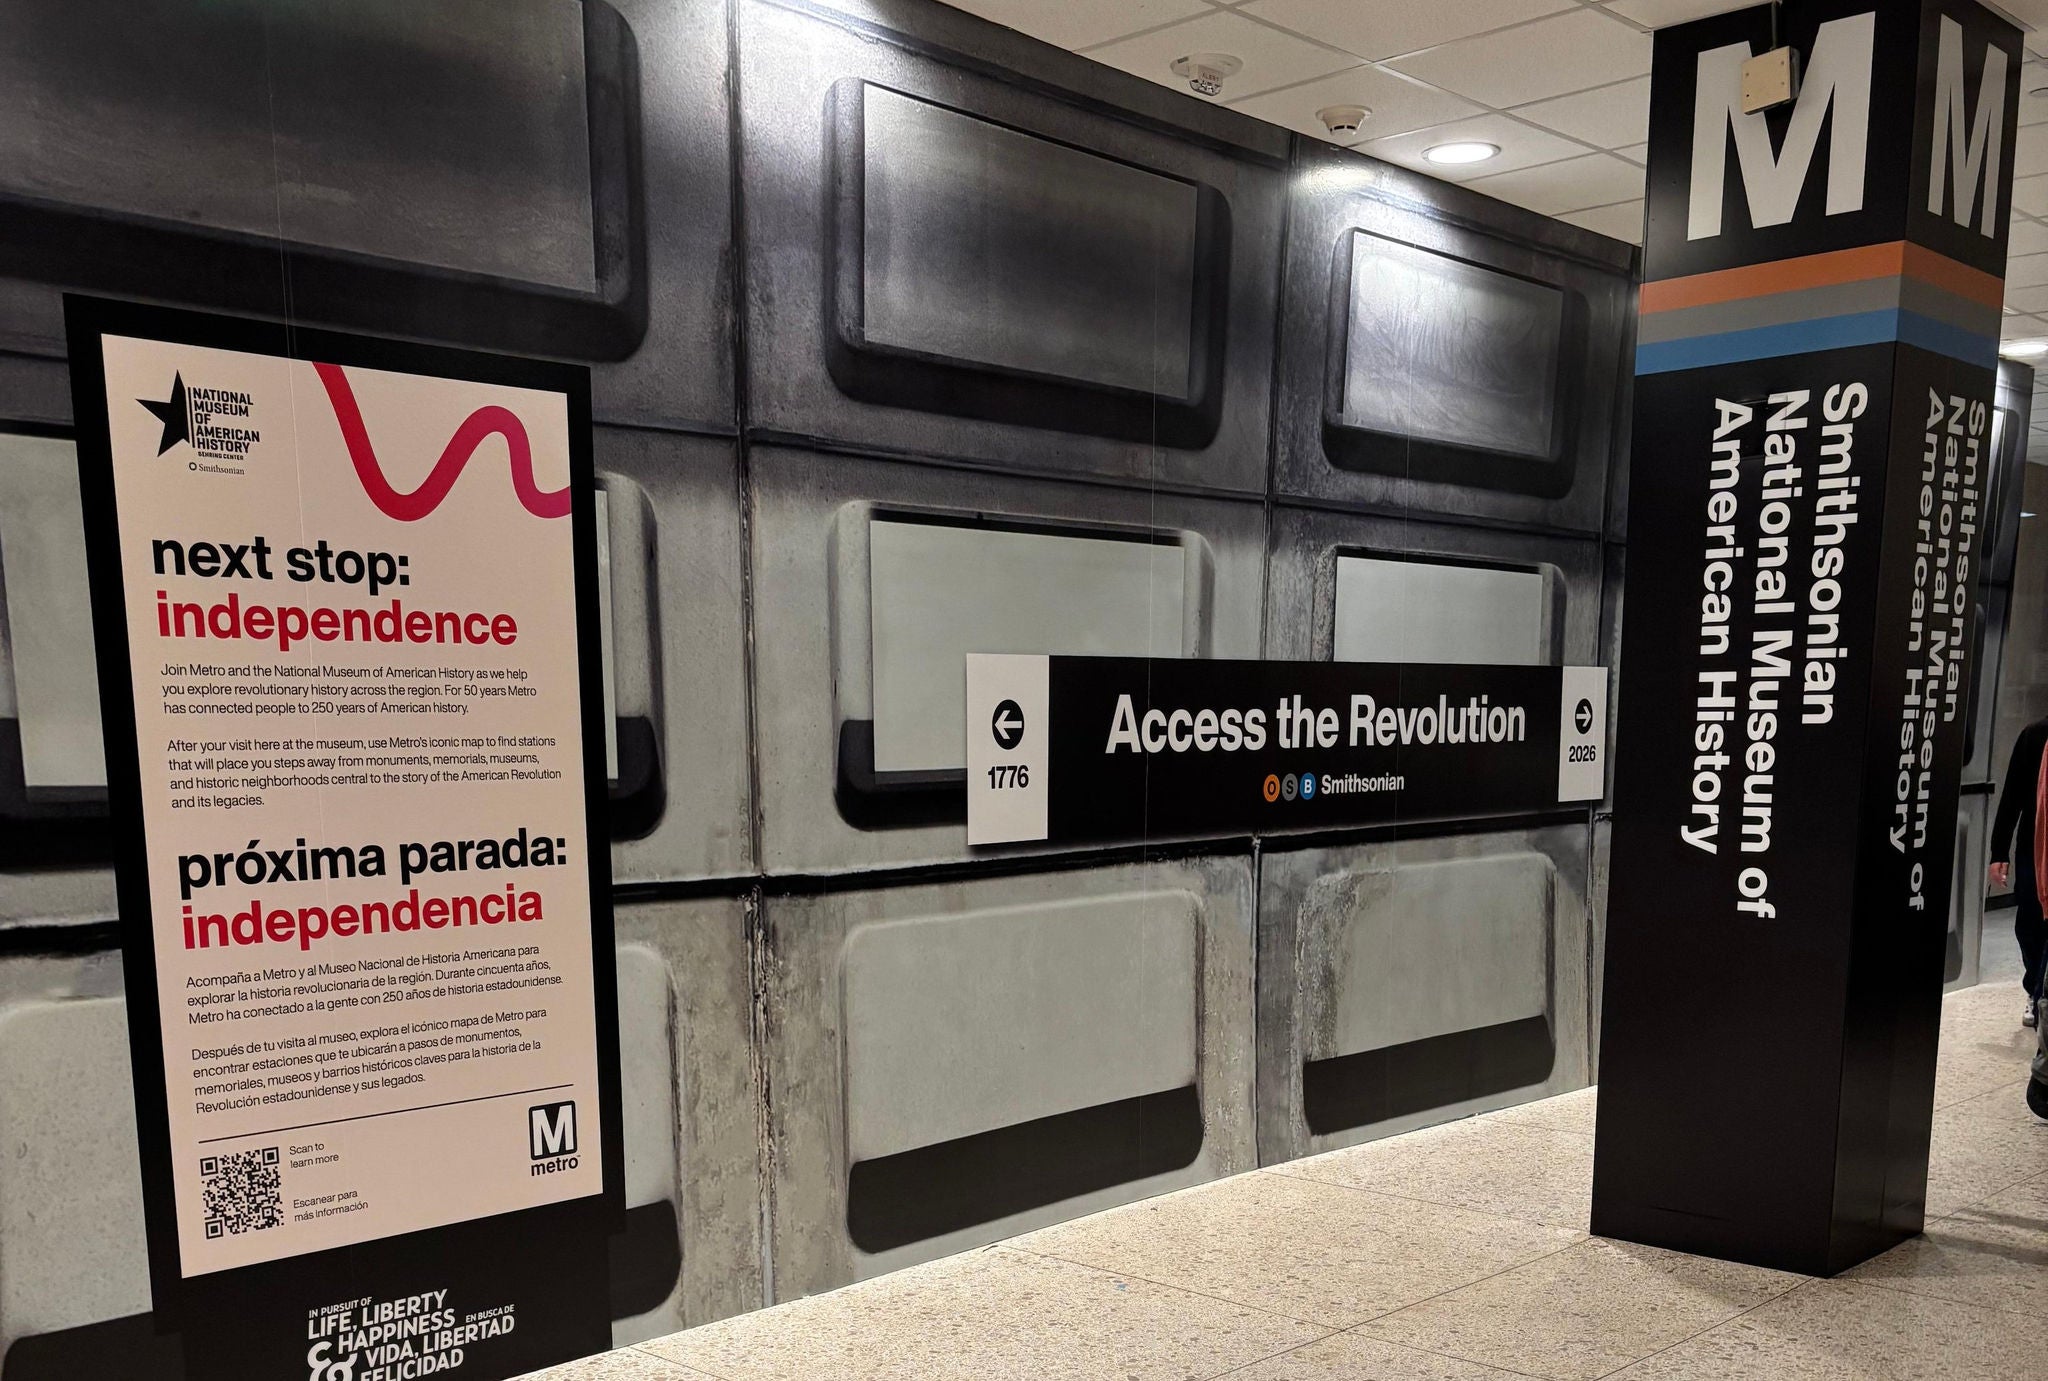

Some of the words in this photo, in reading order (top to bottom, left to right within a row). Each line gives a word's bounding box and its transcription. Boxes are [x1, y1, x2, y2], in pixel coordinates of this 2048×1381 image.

[1687, 11, 1876, 241] M
[1928, 13, 2008, 239] M
[193, 387, 254, 405] NATIONAL
[194, 400, 249, 417] MUSEUM
[195, 413, 211, 424] OF
[196, 425, 260, 442] AMERICAN
[197, 438, 250, 453] HISTORY
[198, 463, 245, 475] Smithsonian
[1754, 390, 1810, 614] National
[1908, 386, 1944, 652] American
[1933, 395, 1966, 614] National
[1700, 398, 1753, 654] American
[151, 535, 274, 580] next
[286, 539, 410, 596] stop:
[1802, 382, 1868, 724] Smithsonian
[1944, 400, 1986, 722] Smithsonian
[156, 589, 518, 652] independence
[160, 662, 187, 676] Join
[188, 663, 226, 676] Metro
[227, 664, 251, 677] and
[252, 664, 272, 677] the
[273, 664, 321, 677] National
[322, 664, 371, 678] Museum
[372, 666, 383, 678] of
[385, 665, 437, 678] American
[437, 666, 475, 682] History
[475, 669, 488, 679] as
[488, 670, 505, 679] we
[505, 667, 528, 682] help
[163, 701, 187, 714] has
[188, 701, 253, 714] connected
[254, 701, 296, 716] people
[297, 702, 310, 714] to
[311, 700, 334, 714] 250
[335, 704, 366, 716] years
[366, 701, 378, 713] of
[379, 701, 432, 713] American
[432, 701, 469, 716] history.
[1105, 694, 1266, 754] Access
[1276, 694, 1340, 749] the
[1350, 694, 1526, 747] Revolution
[166, 739, 198, 752] After
[199, 741, 227, 754] your
[228, 738, 252, 751] visit
[253, 738, 281, 750] here
[282, 738, 294, 750] at
[294, 737, 314, 750] the
[315, 739, 367, 750] museum,
[367, 739, 388, 749] use
[388, 736, 428, 748] Metro's
[428, 736, 460, 748] iconic
[460, 737, 485, 750] map
[485, 736, 496, 747] to
[497, 735, 517, 747] find
[517, 735, 556, 747] stations
[1568, 745, 1596, 762] 2026
[1741, 630, 1794, 852] Museum
[1890, 668, 1923, 854] History
[1913, 630, 1948, 848] Museum
[169, 776, 194, 790] and
[195, 776, 240, 789] historic
[241, 773, 330, 790] neighborhoods
[330, 772, 368, 785] central
[369, 772, 381, 784] to
[382, 771, 400, 783] the
[401, 772, 429, 785] story
[429, 770, 441, 782] of
[441, 770, 460, 782] the
[460, 769, 510, 781] American
[510, 768, 562, 780] Revolution
[988, 765, 1029, 789] 1776
[1267, 781, 1276, 796] O
[1286, 780, 1294, 794] S
[1304, 779, 1312, 794] B
[1321, 772, 1404, 794] Smithsonian
[1680, 671, 1737, 854] History
[171, 795, 195, 809] and
[196, 795, 212, 808] its
[212, 794, 265, 810] legacies.
[177, 837, 386, 901] próxima
[398, 826, 567, 886] parada:
[1909, 862, 1924, 911] of
[1737, 867, 1776, 919] of
[181, 882, 543, 951] independencia
[185, 970, 252, 989] Acompaña
[253, 972, 262, 982] a
[262, 968, 297, 981] Metro
[298, 968, 306, 980] y
[306, 964, 317, 976] al
[318, 962, 356, 975] Museo
[357, 955, 404, 971] Nacional
[405, 954, 420, 967] de
[421, 951, 461, 965] Historia
[462, 948, 516, 961] Americana
[517, 945, 540, 958] para
[186, 992, 236, 1008] explorar
[237, 989, 248, 1001] la
[249, 985, 292, 1000] historia
[292, 976, 370, 995] revolucionaria
[370, 975, 386, 987] de
[387, 974, 397, 985] la
[398, 970, 434, 986] región.
[434, 967, 475, 981] Durante
[476, 962, 525, 976] cincuenta
[525, 959, 551, 971] años,
[191, 1043, 245, 1061] Después
[245, 1041, 262, 1054] de
[262, 1040, 275, 1052] tu
[276, 1036, 306, 1050] visita
[306, 1033, 317, 1046] al
[318, 1031, 358, 1045] museo,
[359, 1026, 399, 1041] explora
[400, 1022, 410, 1034] el
[410, 1020, 449, 1033] icónico
[450, 1016, 479, 1029] mapa
[480, 1013, 494, 1025] de
[494, 1010, 524, 1023] Metro
[524, 1008, 547, 1021] para
[195, 1094, 261, 1114] Revolución
[261, 1083, 351, 1105] estadounidense
[352, 1082, 360, 1094] y
[360, 1079, 380, 1090] sus
[380, 1072, 426, 1089] legados.
[288, 1144, 314, 1156] Scan
[314, 1142, 325, 1151] to
[532, 1104, 574, 1156] M
[289, 1158, 314, 1168] learn
[314, 1153, 339, 1164] more
[531, 1157, 578, 1176] metro
[292, 1193, 336, 1209] Escanear
[336, 1190, 358, 1203] para
[293, 1210, 314, 1222] más
[314, 1200, 369, 1218] información
[308, 1312, 357, 1340] LIFE,
[362, 1288, 448, 1327] LIBERTY
[309, 1310, 318, 1319] IN
[321, 1300, 359, 1316] PURSUIT
[360, 1297, 373, 1307] OF
[338, 1308, 456, 1354] HAPPINESS
[465, 1314, 476, 1323] EN
[478, 1307, 503, 1321] BUSCA
[504, 1304, 515, 1314] DE
[360, 1348, 464, 1381] FELICIDAD
[365, 1340, 419, 1368] VIDA,
[423, 1315, 515, 1354] LIBERTAD
